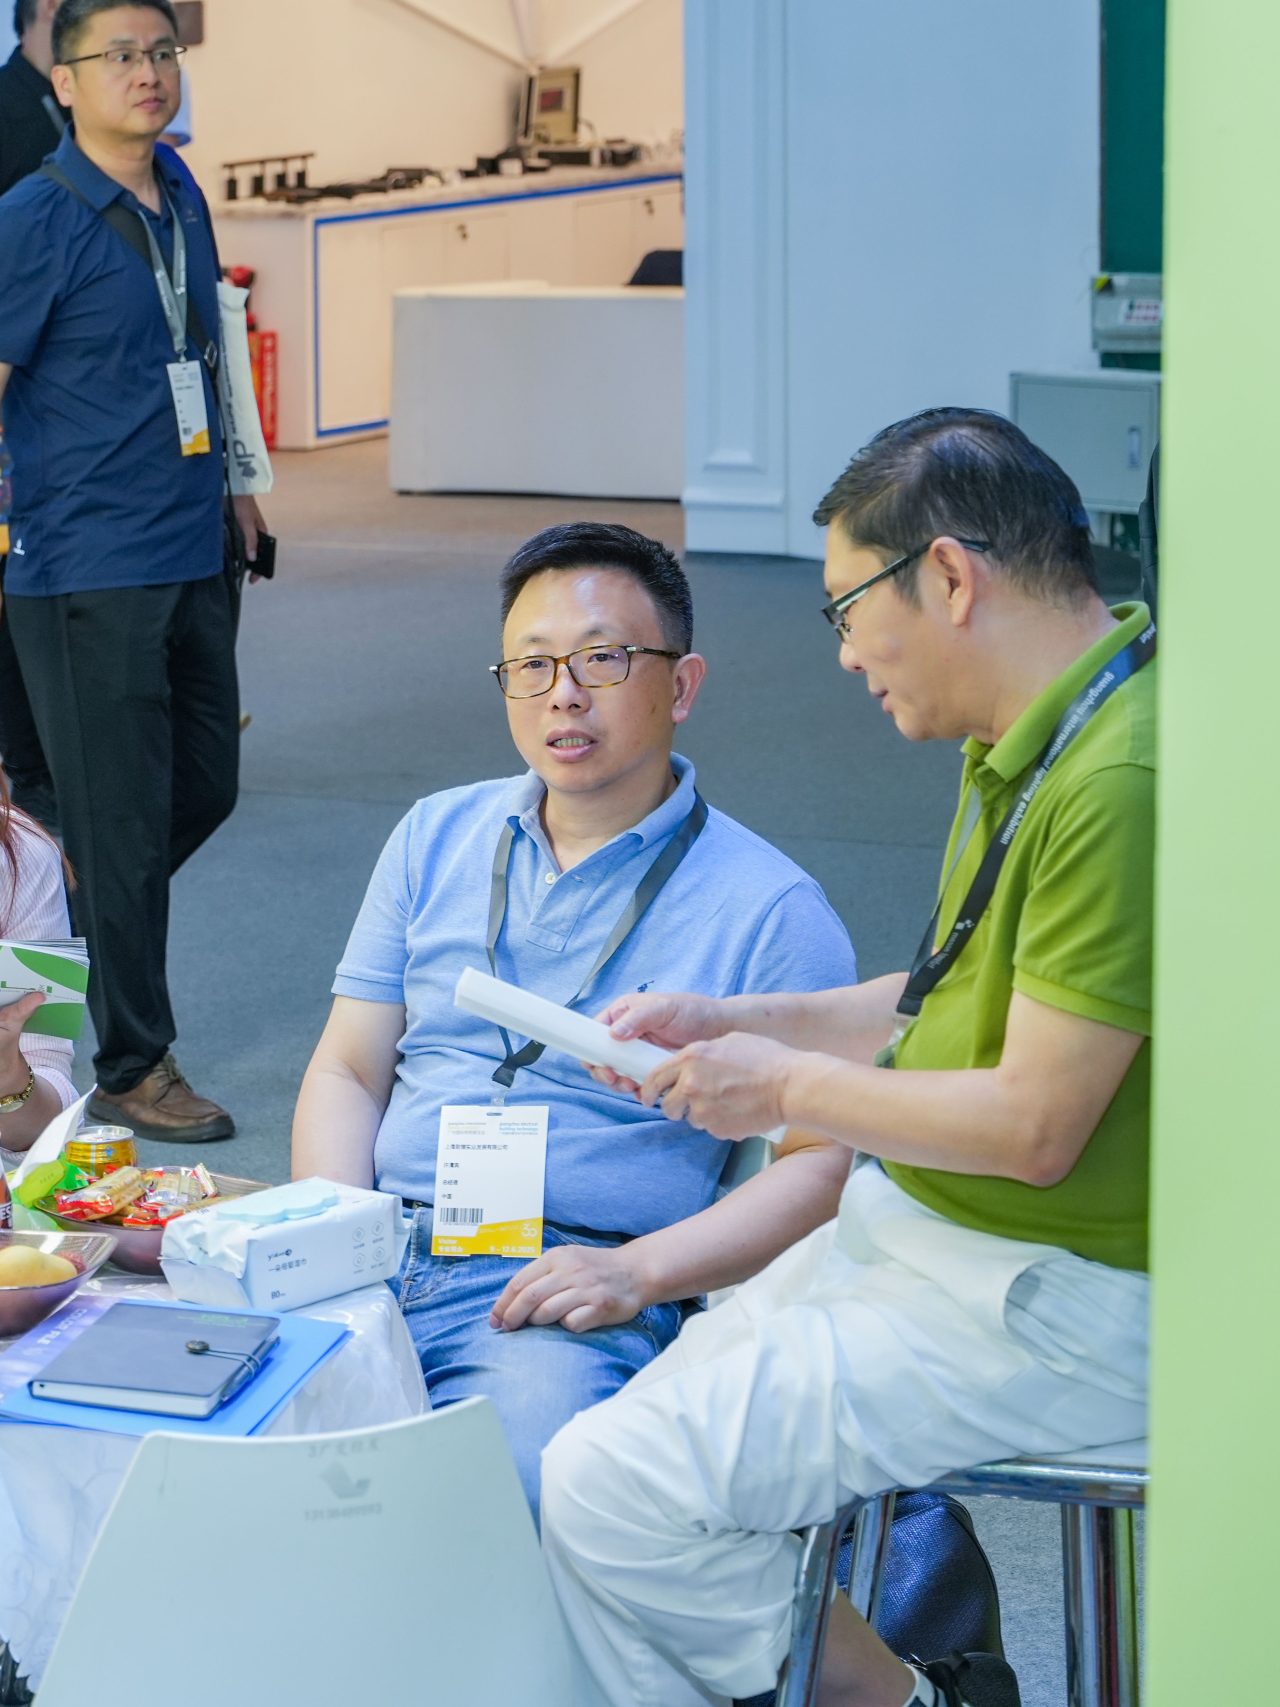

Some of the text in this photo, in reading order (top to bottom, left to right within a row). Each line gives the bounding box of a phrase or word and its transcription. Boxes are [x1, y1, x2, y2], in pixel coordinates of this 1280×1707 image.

[1000, 671, 1115, 846] guangzhou international lighting exhibition
